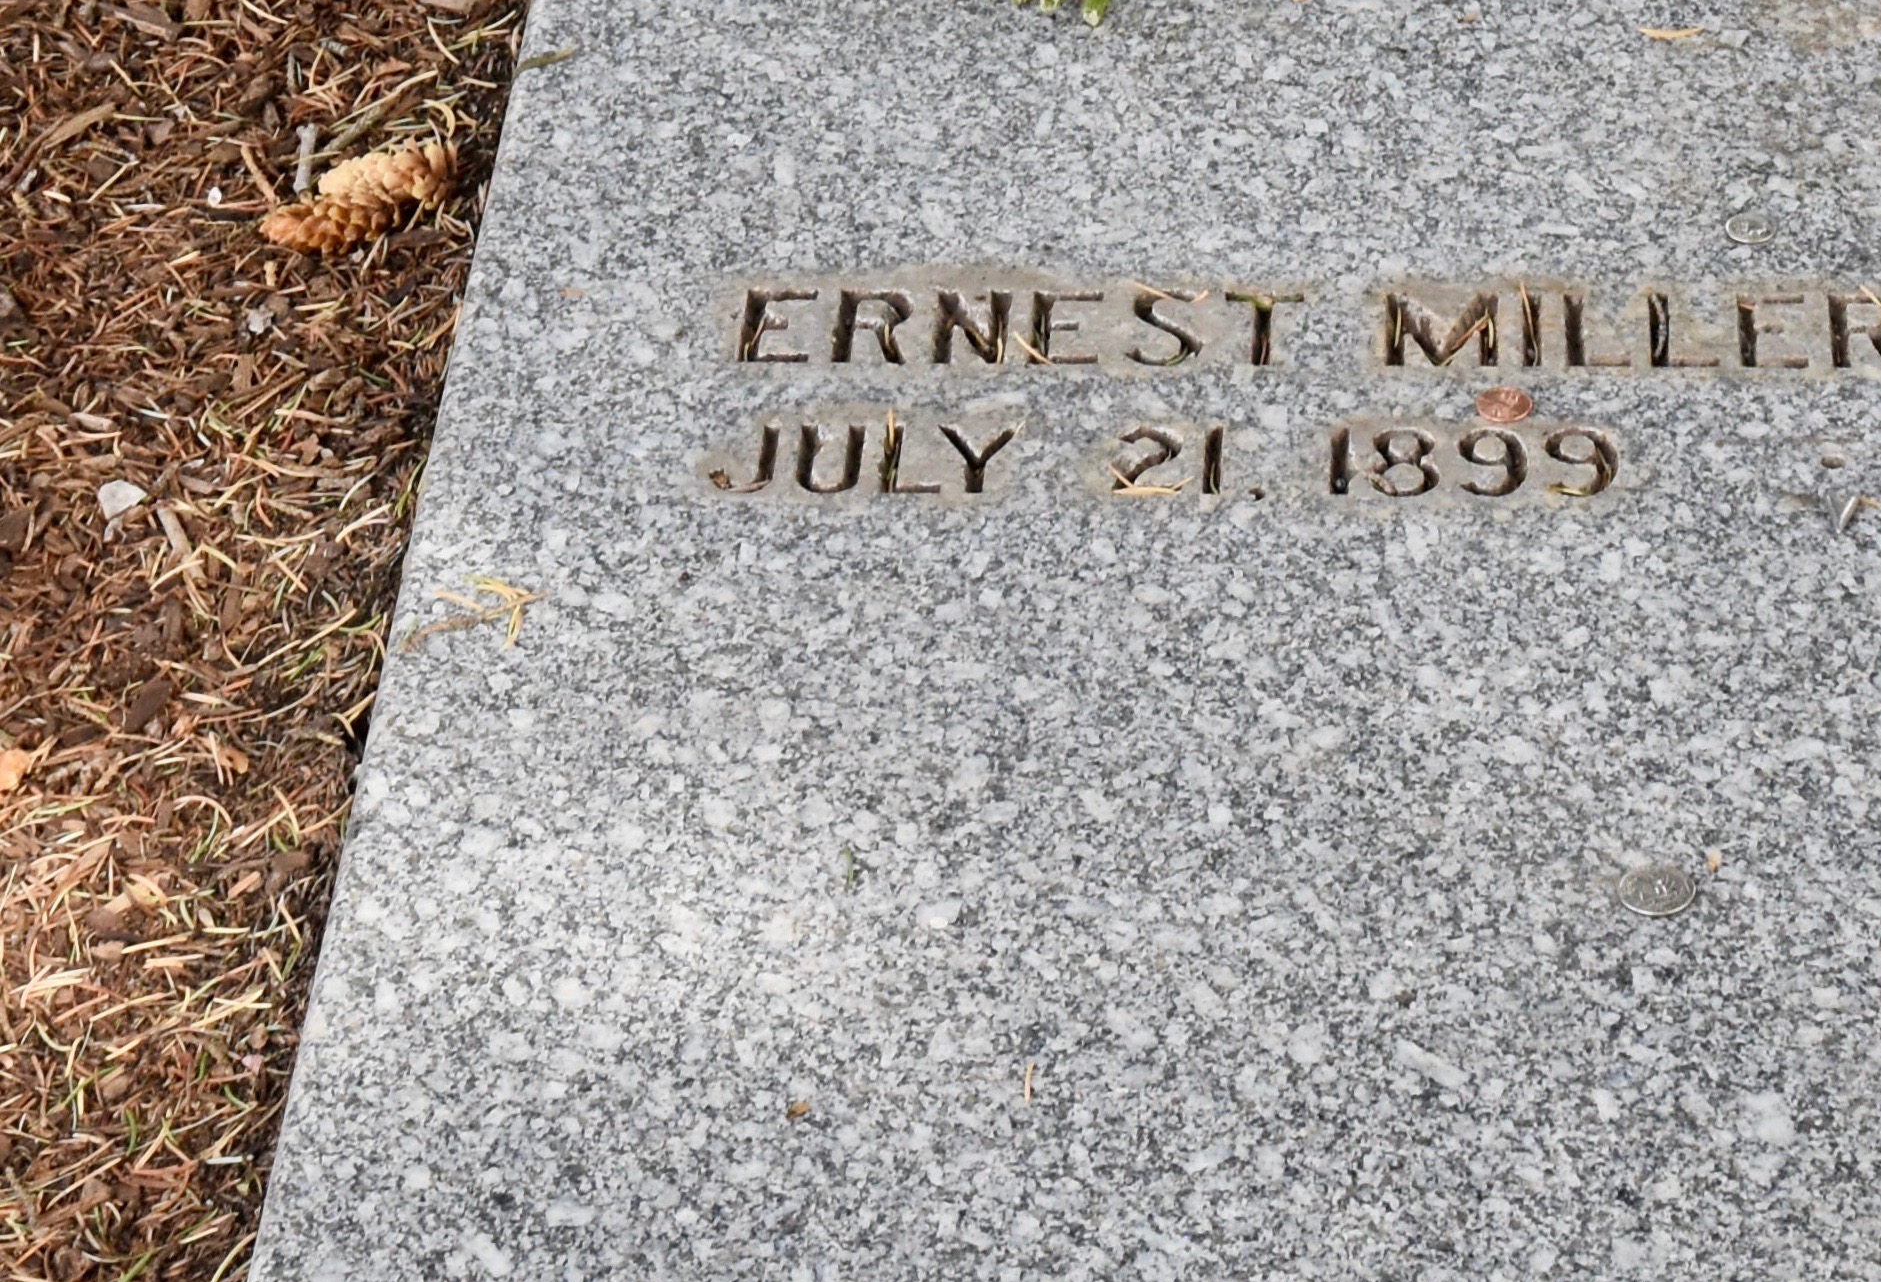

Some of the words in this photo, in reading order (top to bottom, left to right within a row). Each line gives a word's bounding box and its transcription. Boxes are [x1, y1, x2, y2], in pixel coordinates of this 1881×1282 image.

[738, 289, 1304, 366] ERNEST
[709, 422, 1021, 493] JULY
[1328, 426, 1619, 496] 1899
